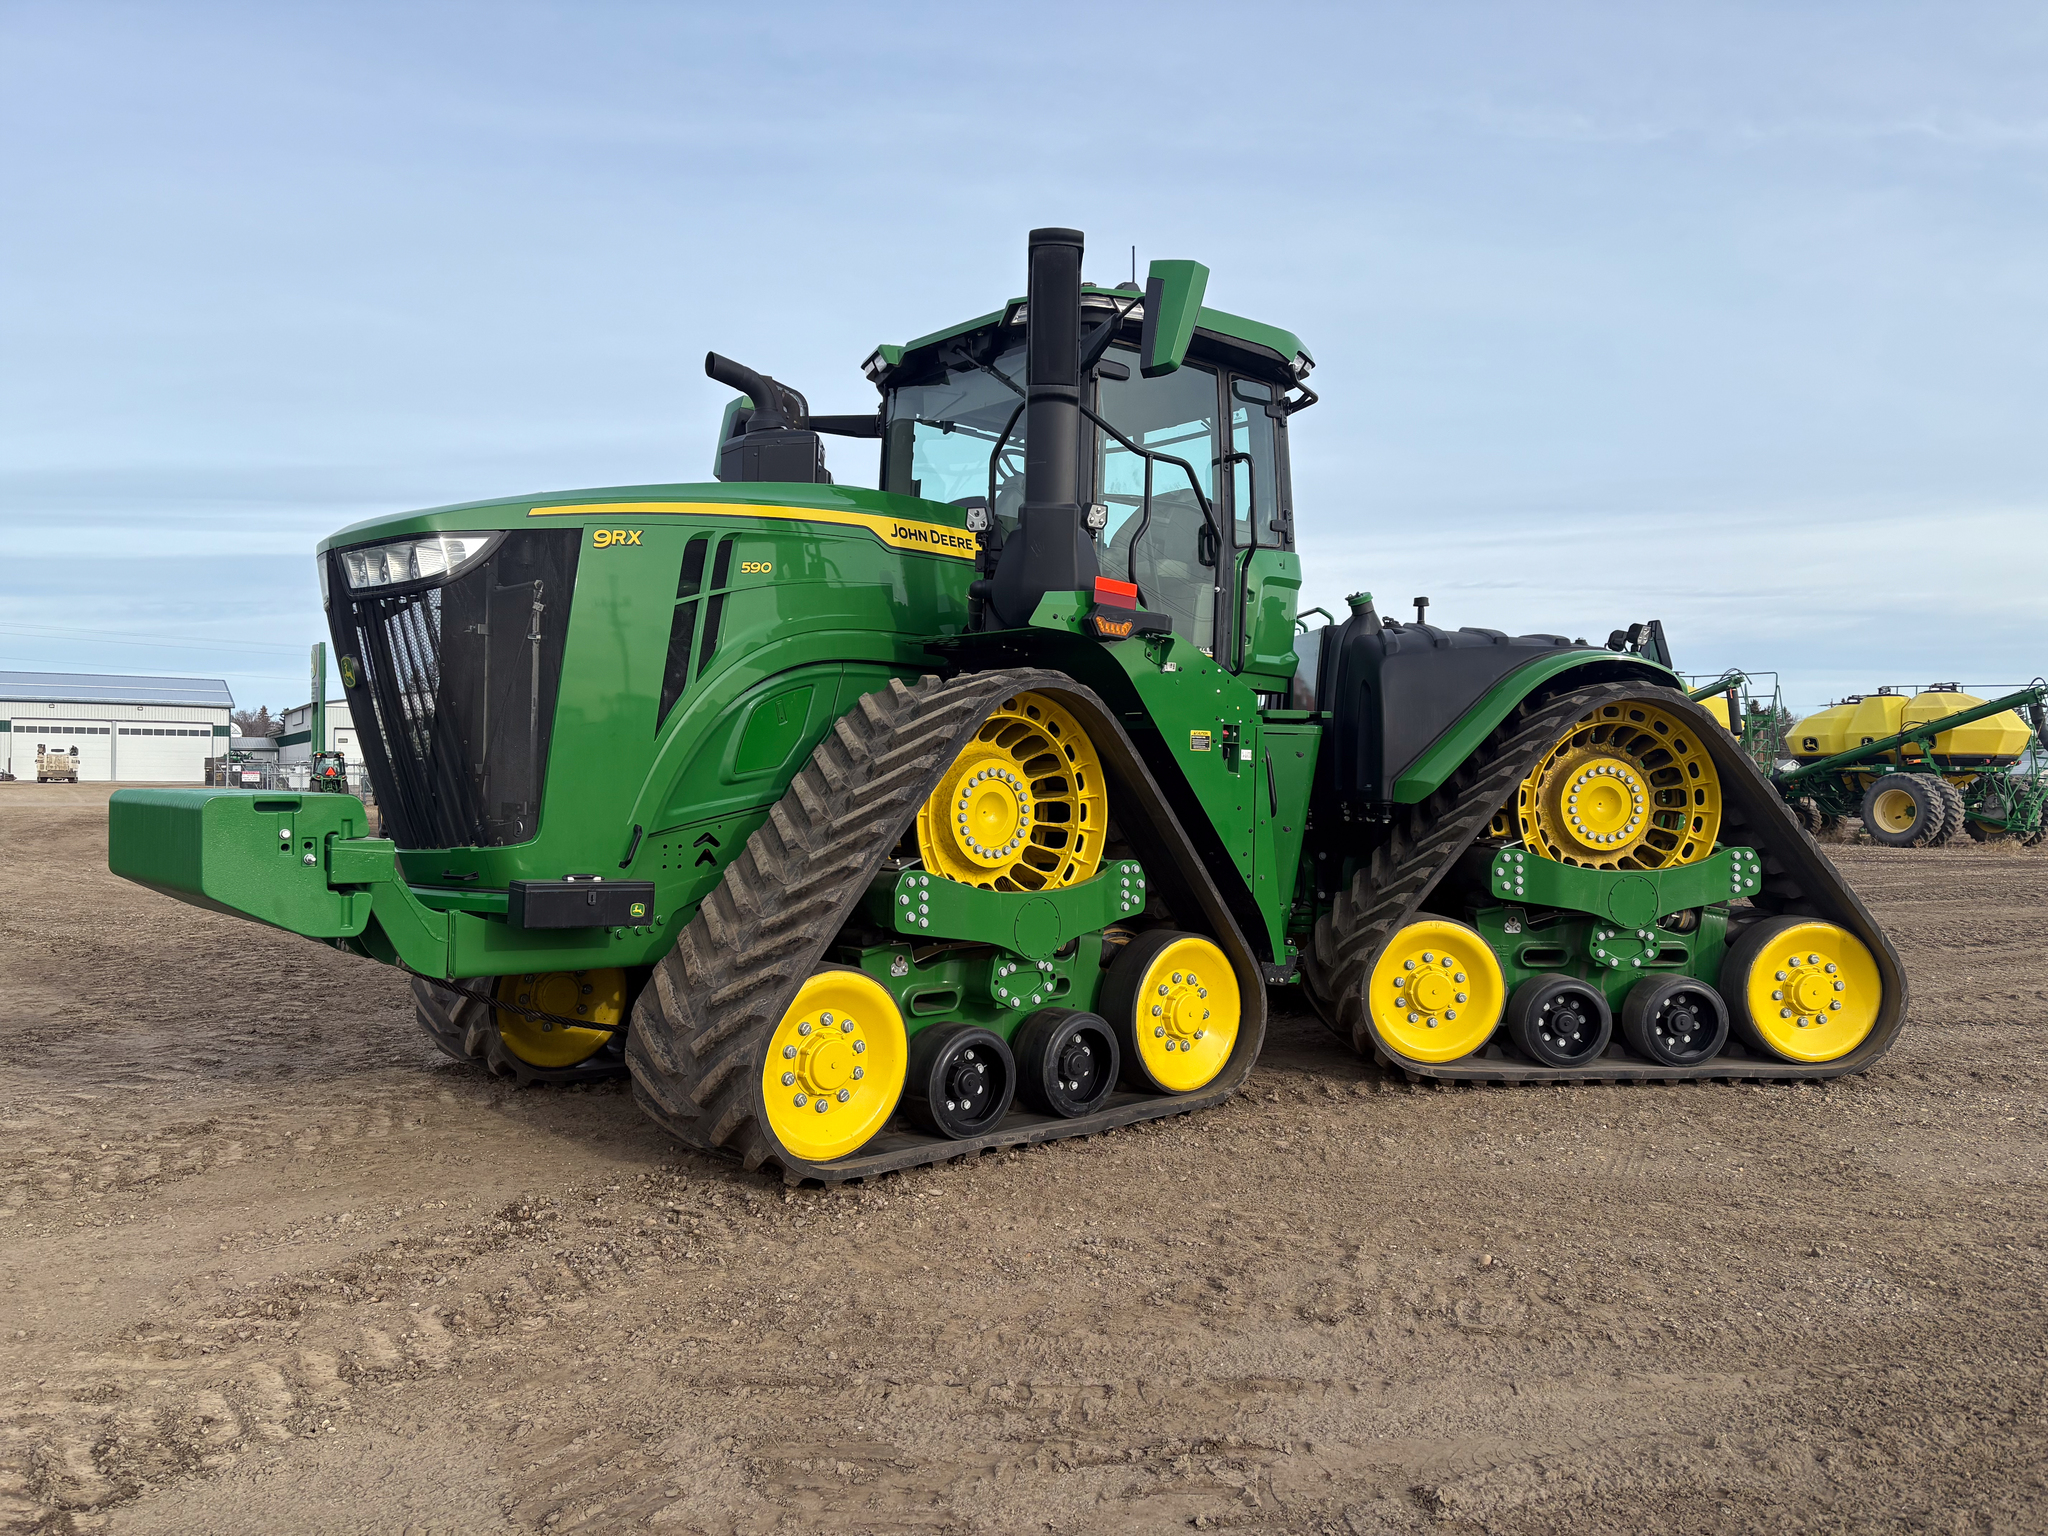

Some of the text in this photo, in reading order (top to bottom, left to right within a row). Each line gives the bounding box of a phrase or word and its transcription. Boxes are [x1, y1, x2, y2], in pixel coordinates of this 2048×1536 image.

[593, 529, 643, 549] 9RX
[891, 523, 974, 551] JOHN DEERE
[741, 561, 772, 574] 590
